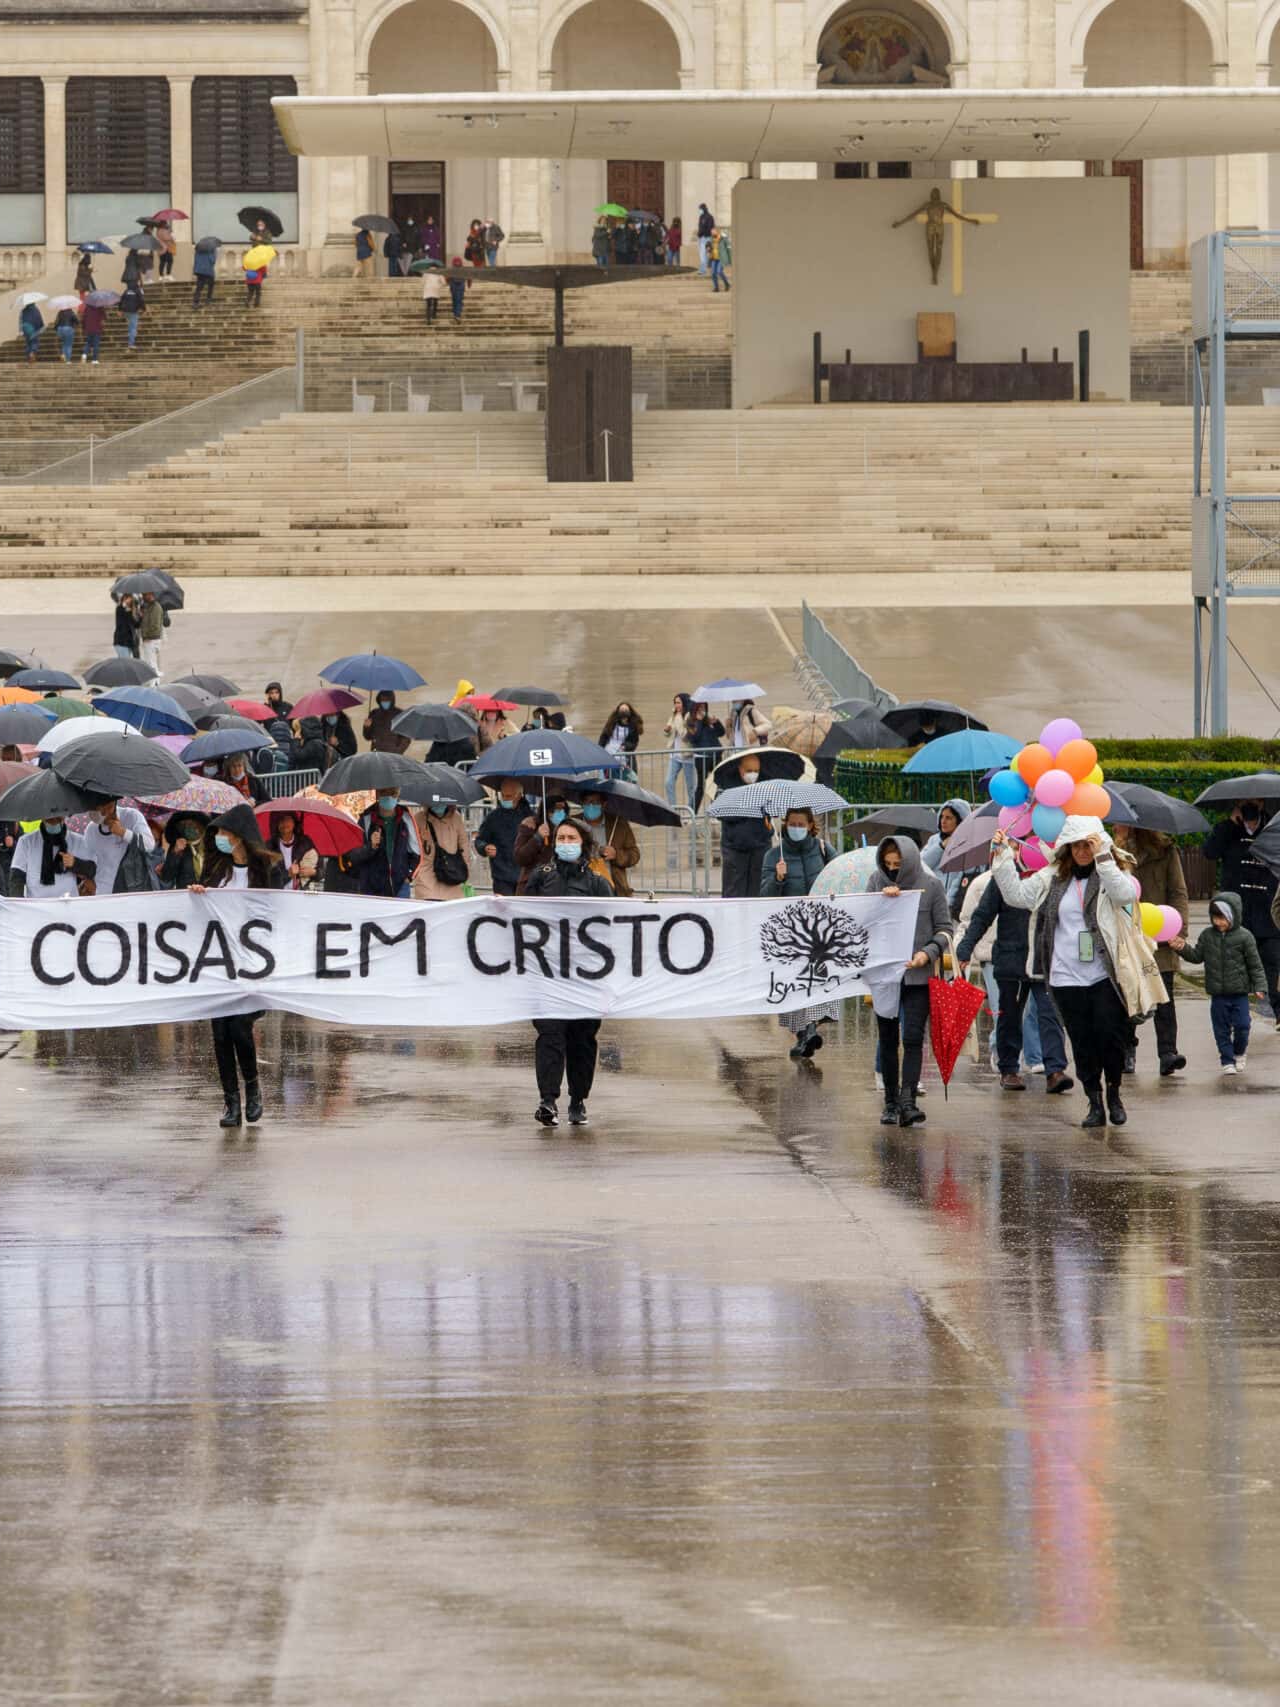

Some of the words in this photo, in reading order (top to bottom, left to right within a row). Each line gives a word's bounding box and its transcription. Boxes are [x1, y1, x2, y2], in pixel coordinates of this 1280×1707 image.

[30, 919, 277, 986] COISAS
[315, 918, 427, 979] EM
[467, 913, 715, 980] CRISTO
